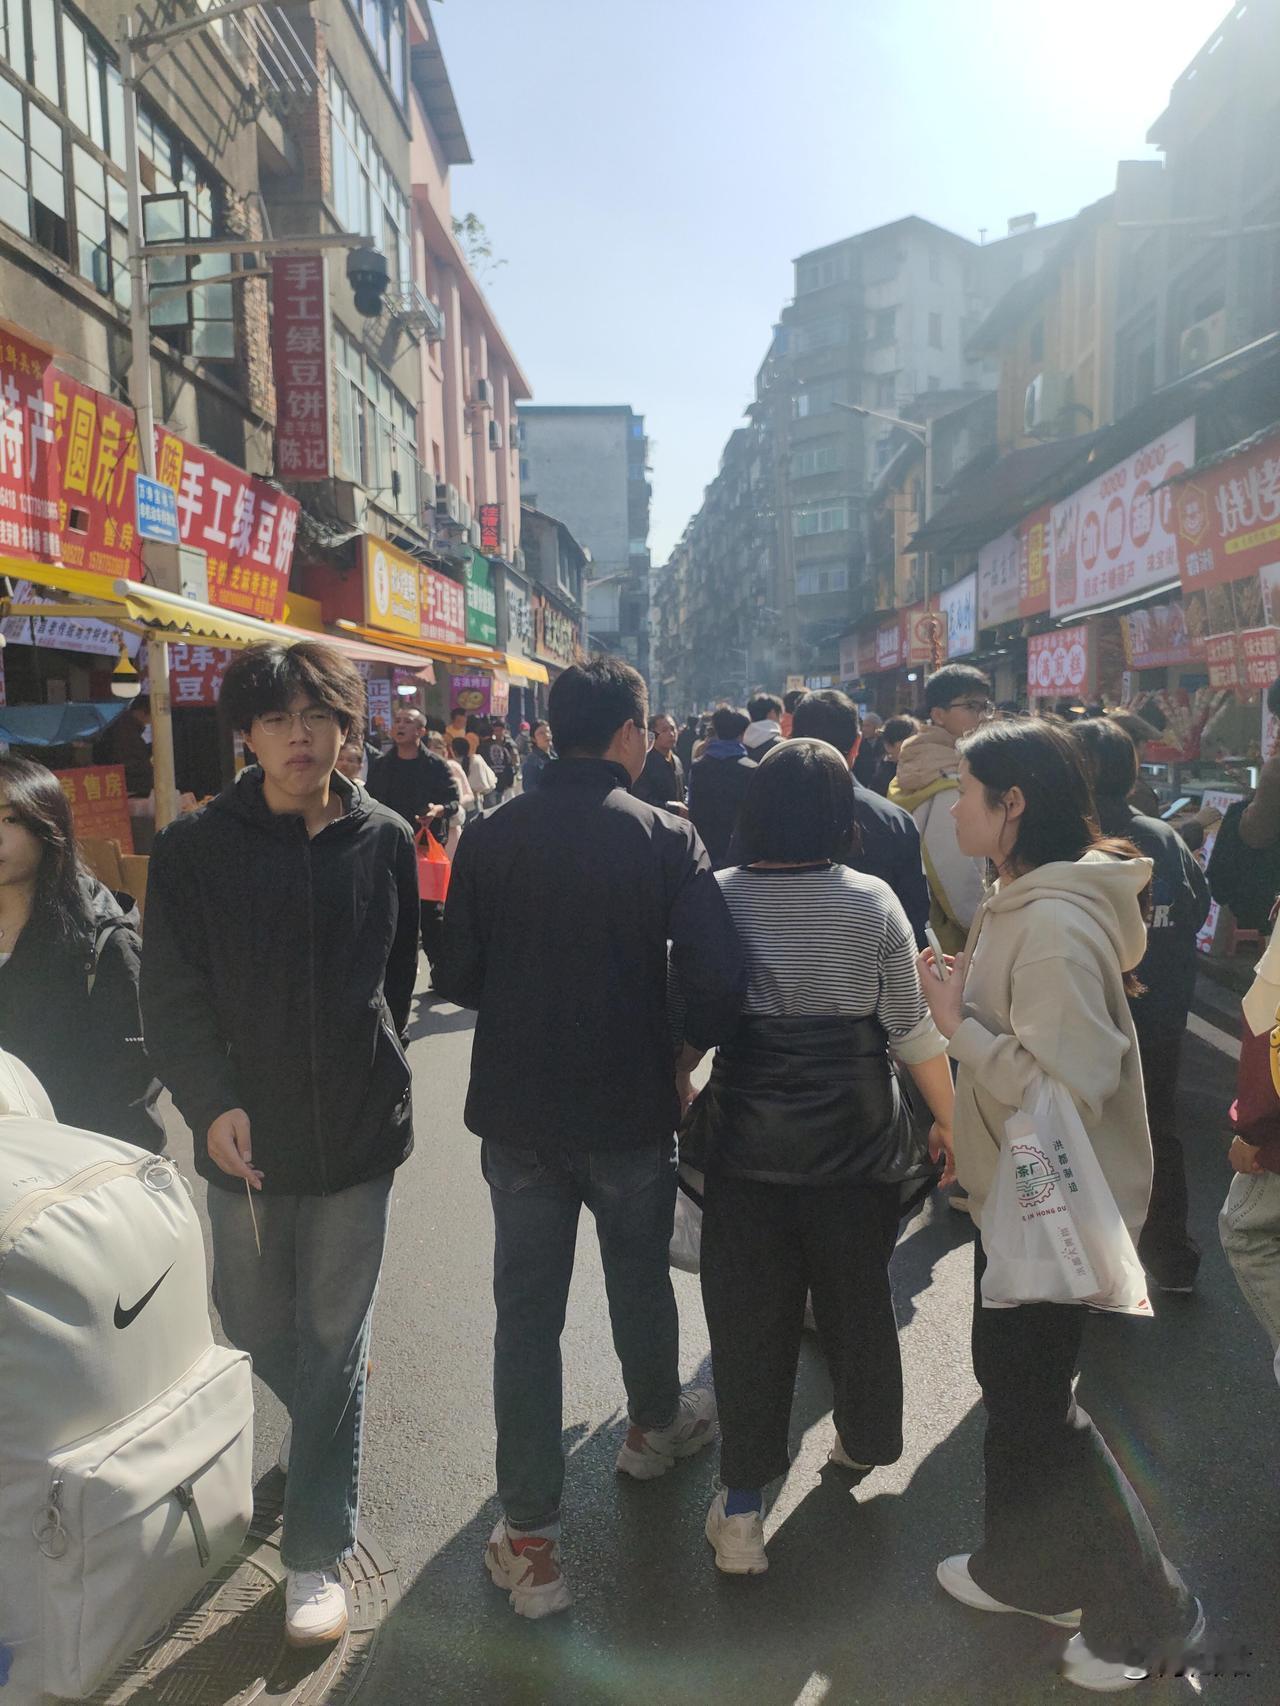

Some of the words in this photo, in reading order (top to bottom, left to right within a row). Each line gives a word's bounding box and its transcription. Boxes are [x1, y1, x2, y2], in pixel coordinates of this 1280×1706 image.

[285, 263, 322, 419] 手工绿豆饼
[279, 439, 326, 471] 陈记
[177, 460, 297, 575] 手工绿豆饼
[1015, 1161, 1040, 1179] 茶厂
[1036, 1207, 1056, 1217] HONG
